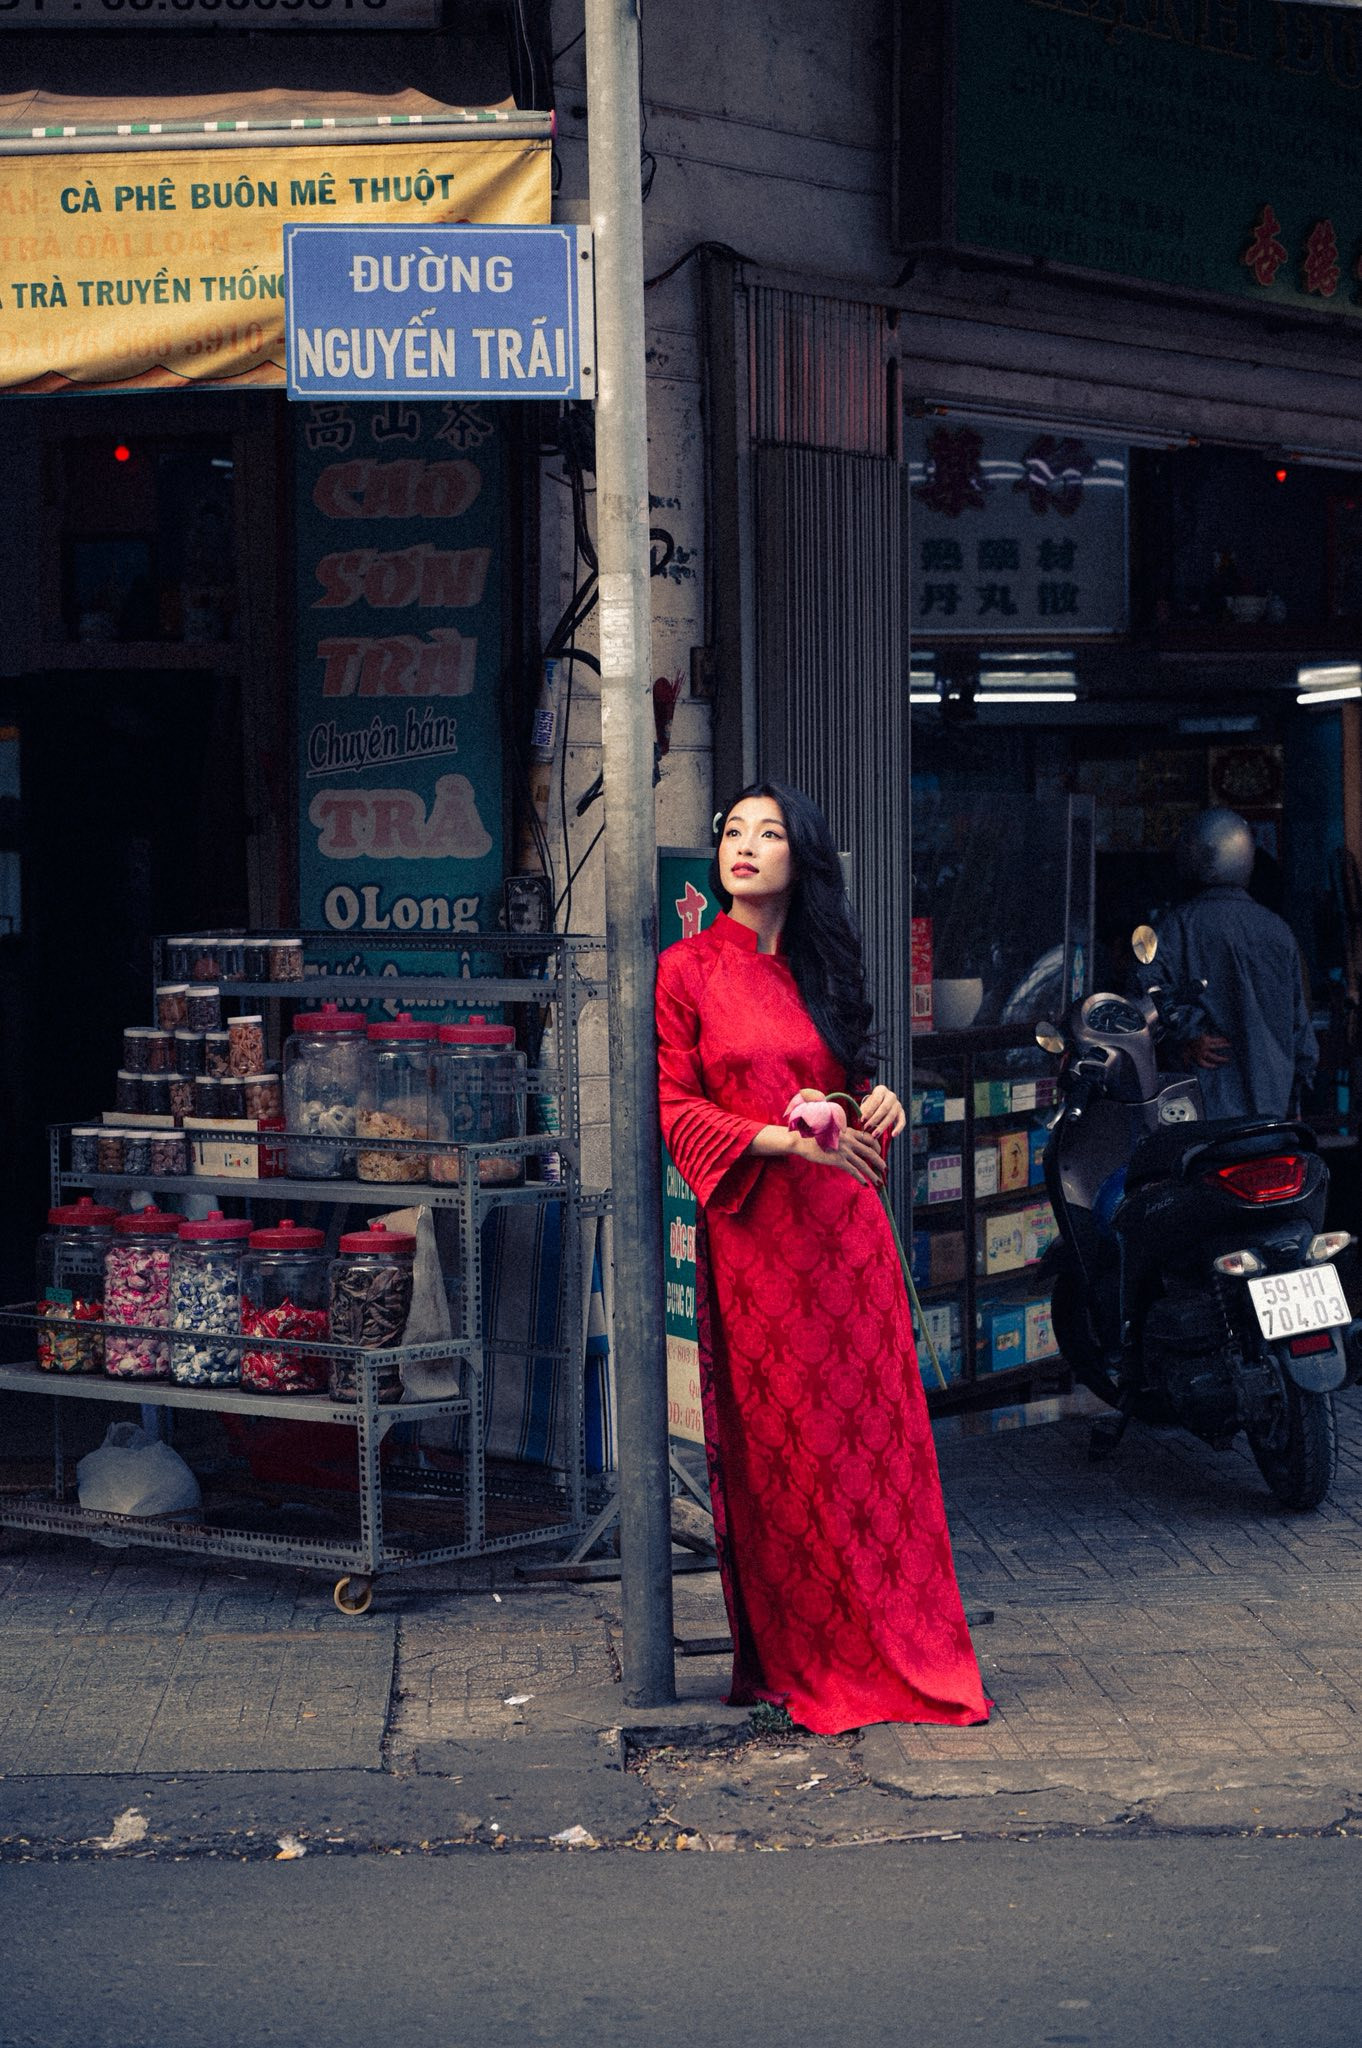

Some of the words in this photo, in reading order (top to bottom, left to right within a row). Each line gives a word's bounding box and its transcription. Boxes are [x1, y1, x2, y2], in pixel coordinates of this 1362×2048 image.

[60, 180, 102, 214] CÀ
[115, 176, 176, 212] PHÊ
[191, 174, 278, 210] BUÔN
[290, 172, 337, 207] MÊ
[349, 168, 455, 207] THUỘT
[12, 275, 68, 309] TRÀ
[77, 267, 190, 306] TRUYỀN
[349, 246, 514, 294] ĐƯỜNG
[297, 307, 455, 380] NGUYỄN
[472, 315, 566, 380] TRÃI
[307, 714, 399, 771] Chuyên
[405, 705, 458, 753] bán:
[322, 884, 482, 933] OLong
[1261, 1270, 1326, 1306] 59-H1
[1261, 1296, 1345, 1336] 704.03
